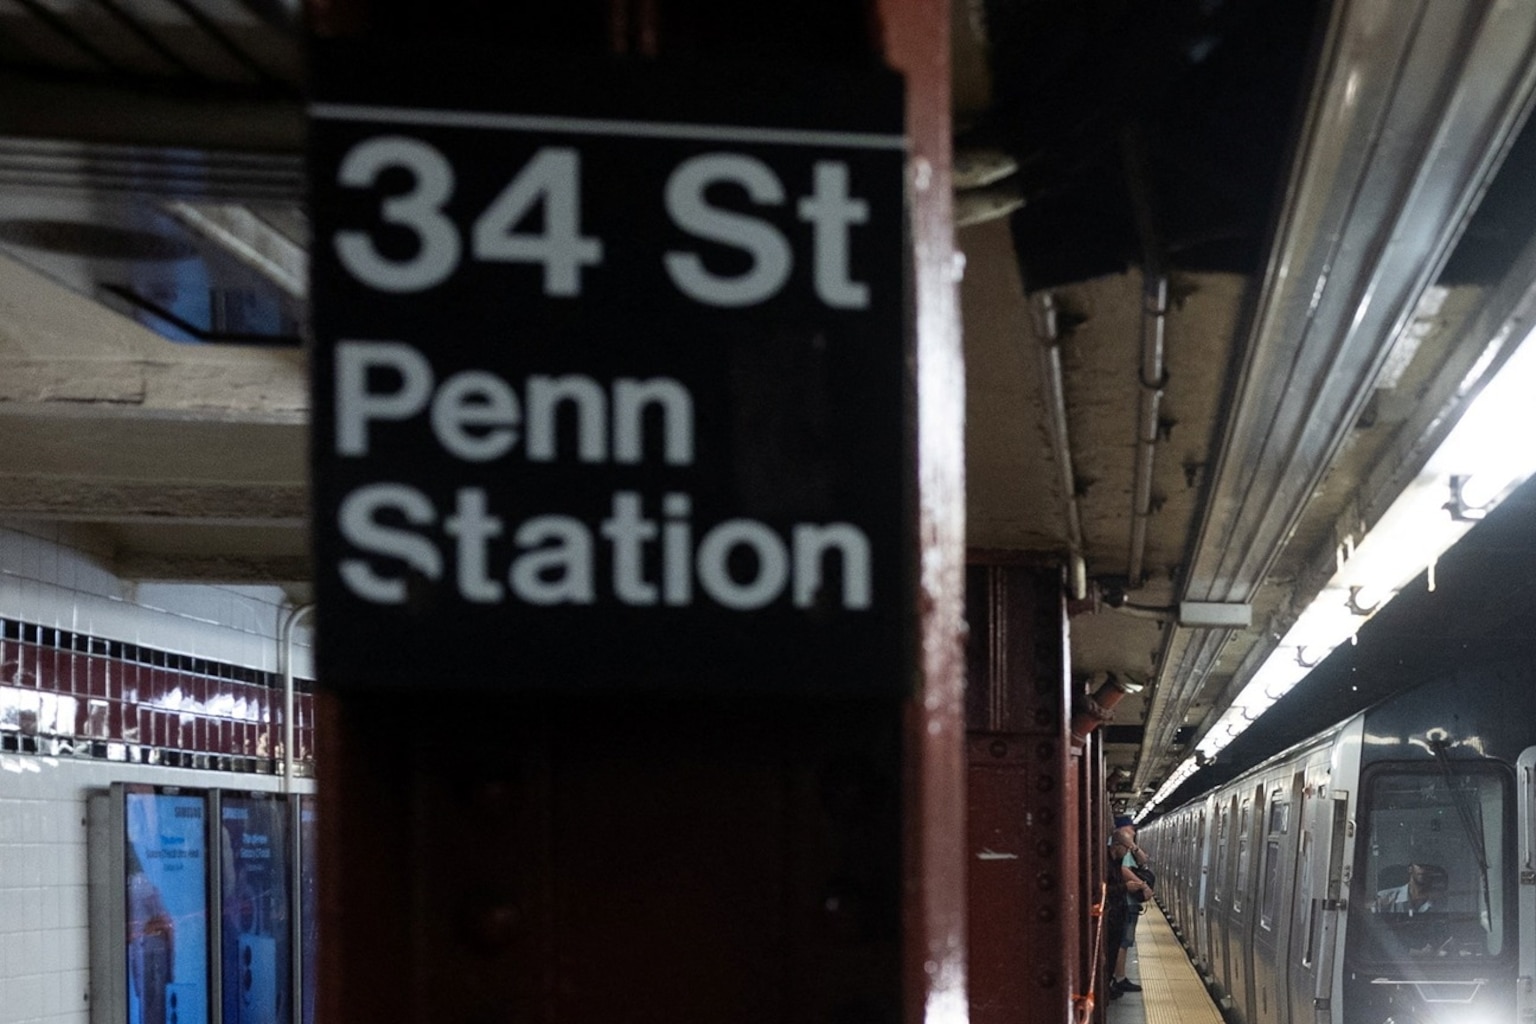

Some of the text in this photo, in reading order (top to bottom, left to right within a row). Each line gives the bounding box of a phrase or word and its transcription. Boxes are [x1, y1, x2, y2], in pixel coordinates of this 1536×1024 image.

[333, 135, 870, 309] 34 St
[333, 340, 694, 465] Penn
[337, 482, 872, 609] Station
